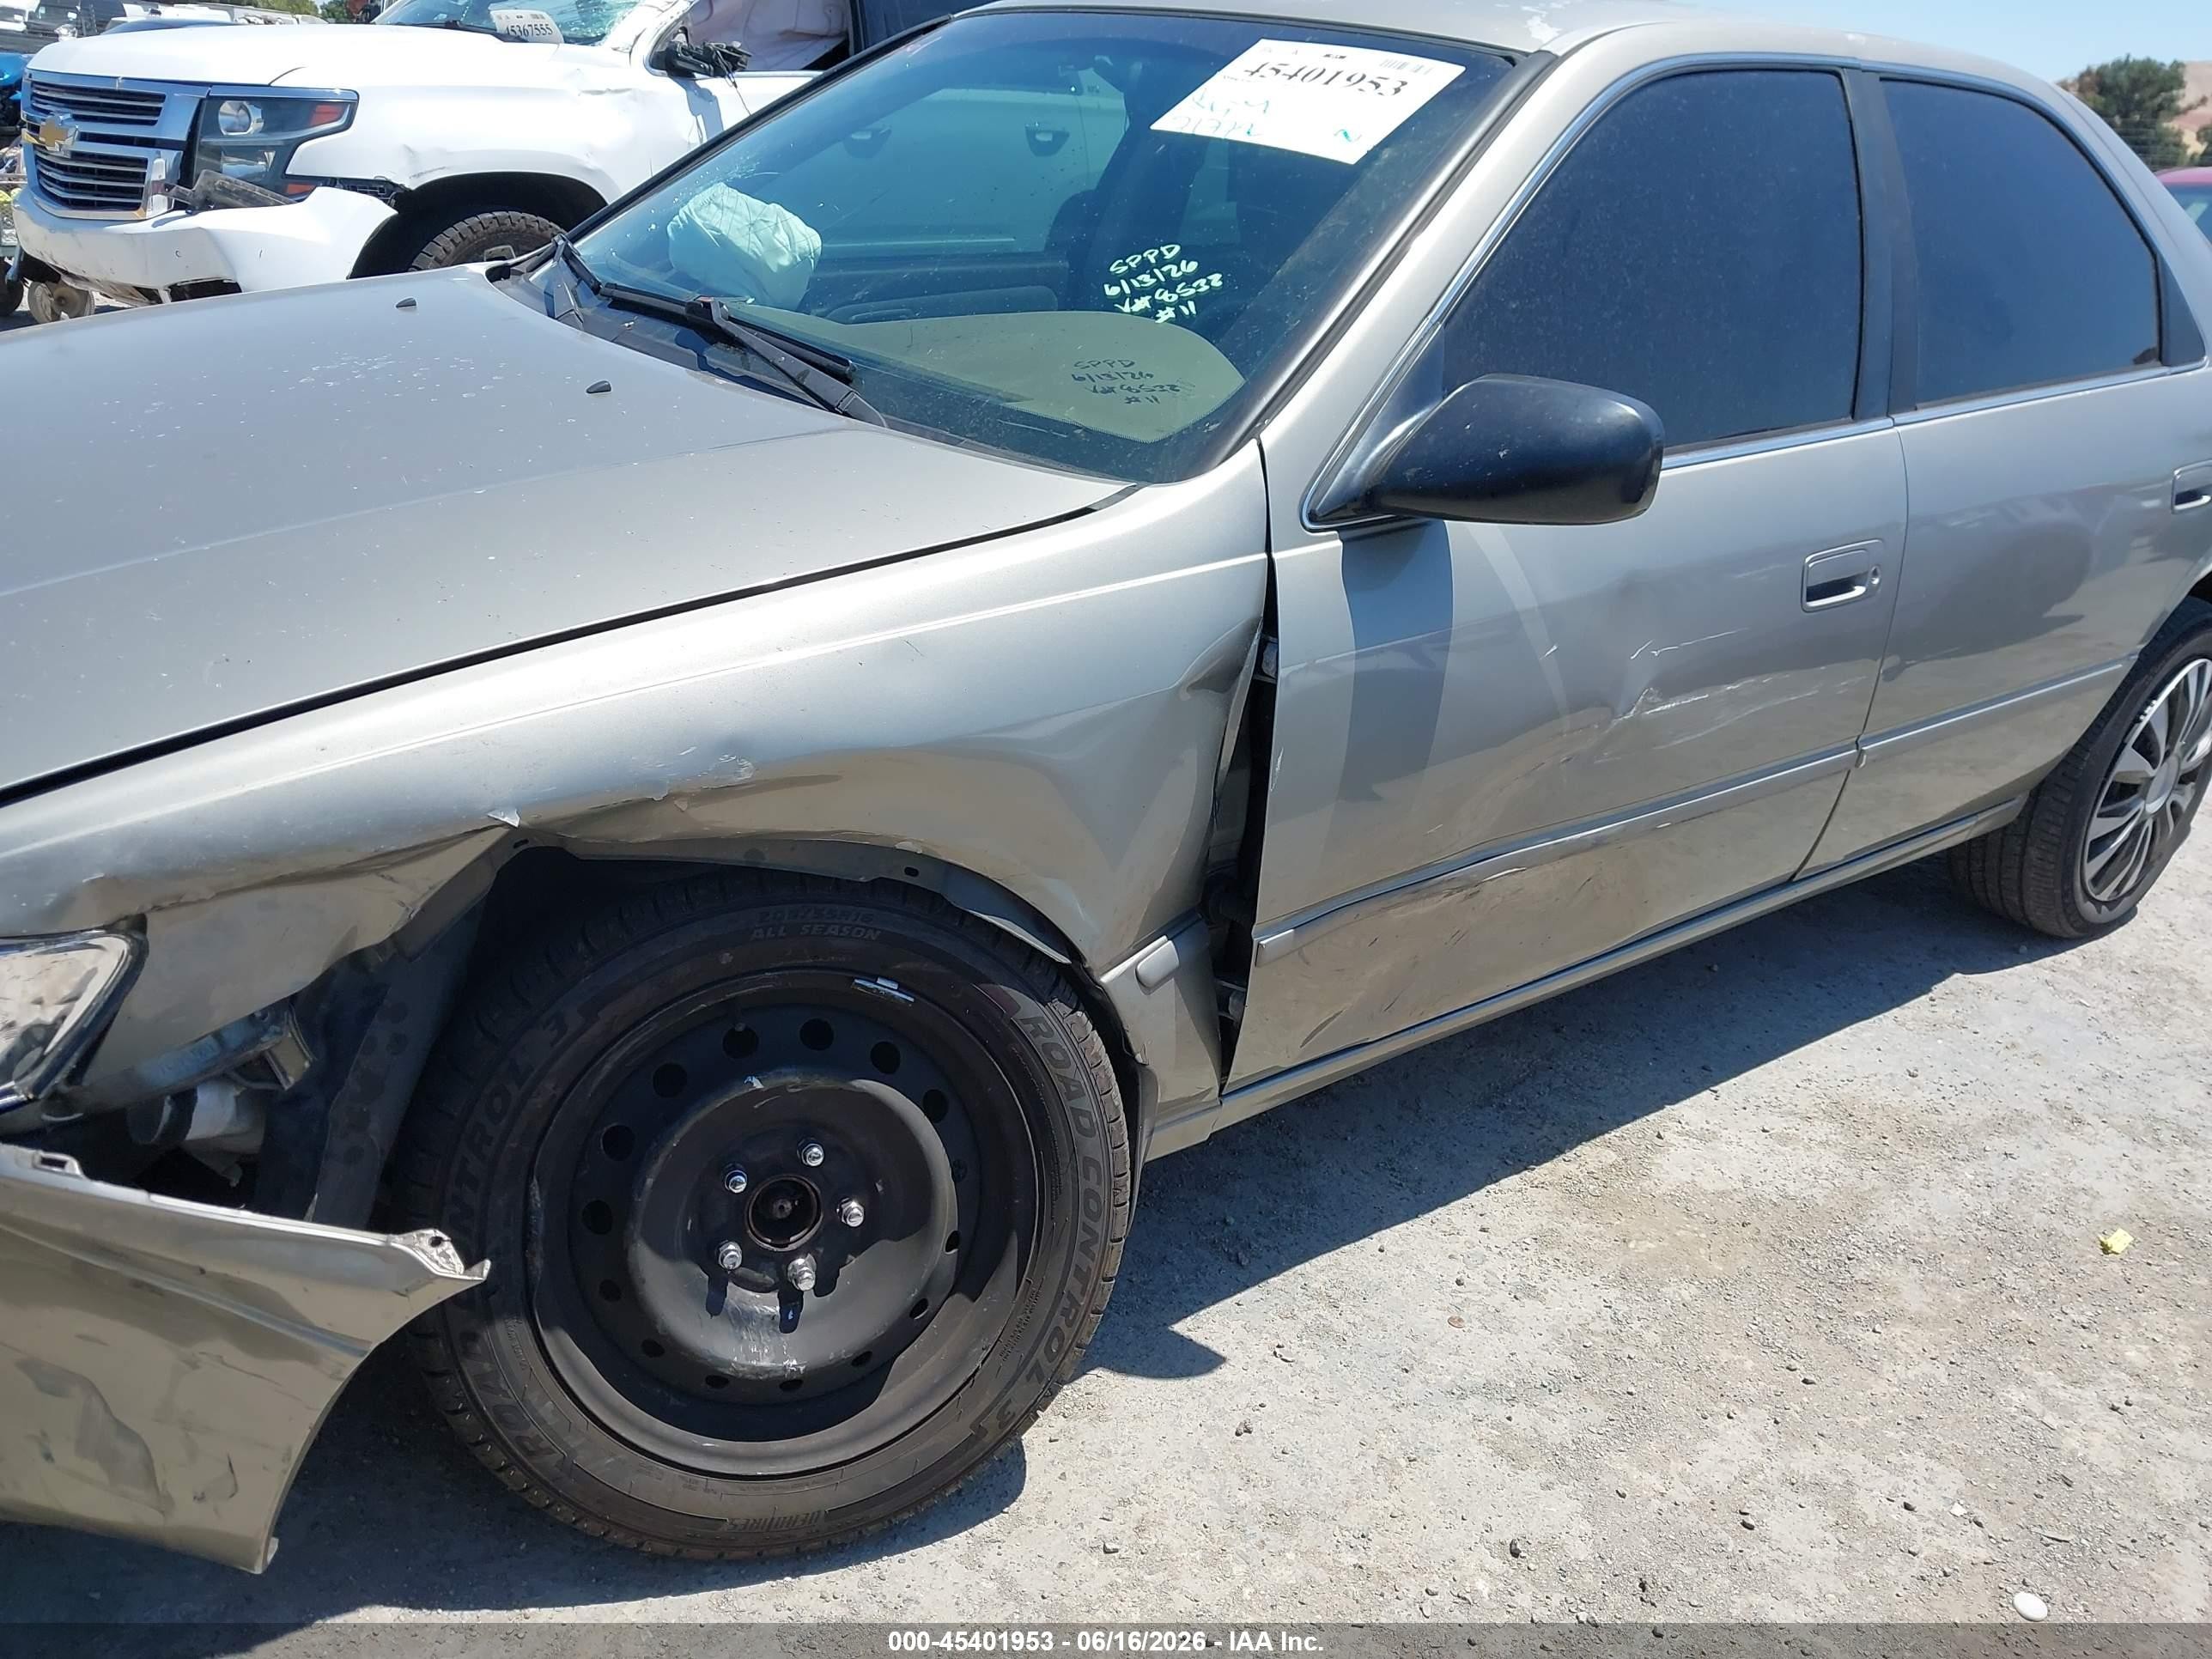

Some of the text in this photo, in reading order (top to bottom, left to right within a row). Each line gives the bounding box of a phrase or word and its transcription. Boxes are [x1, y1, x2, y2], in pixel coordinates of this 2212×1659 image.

[1244, 61, 1408, 96] 45401953
[1103, 259, 1199, 296] 6/13/26
[1109, 244, 1181, 275] SPPD
[750, 924, 882, 941] ALL SEASON
[1021, 1014, 1098, 1139] ROAD
[1024, 1155, 1105, 1391] CONTROL
